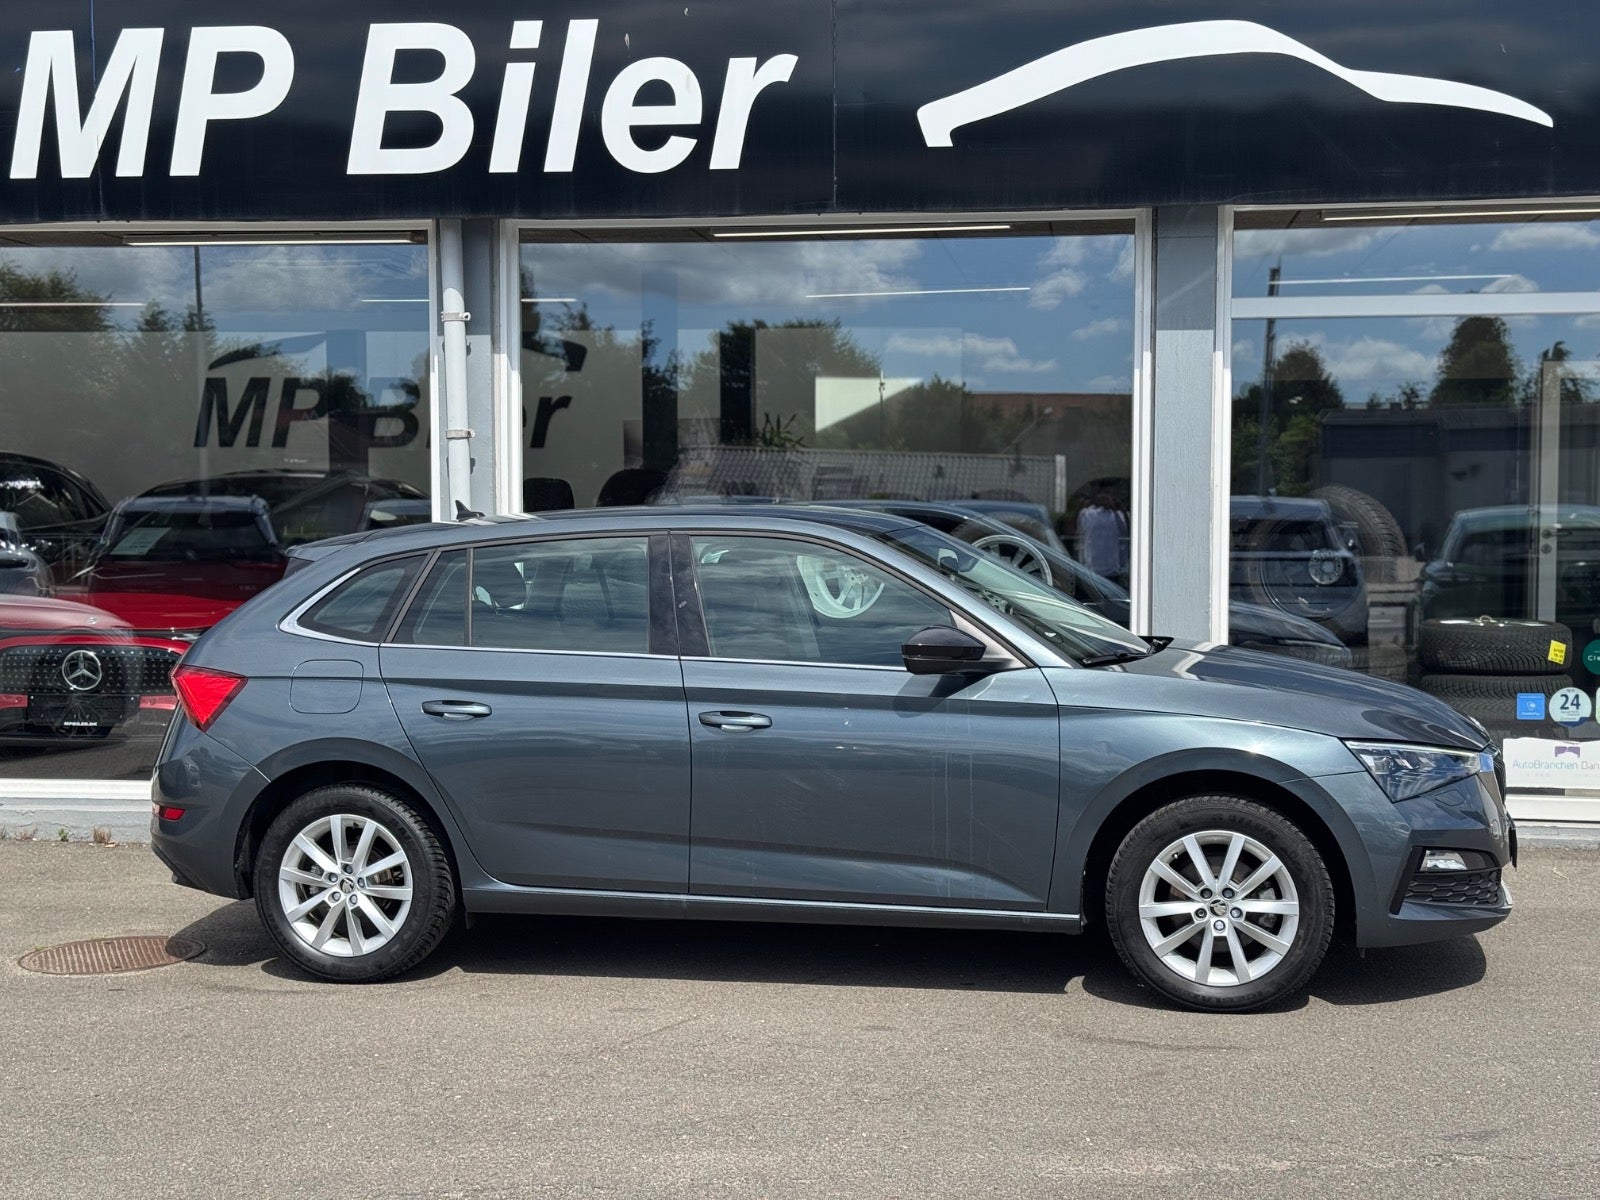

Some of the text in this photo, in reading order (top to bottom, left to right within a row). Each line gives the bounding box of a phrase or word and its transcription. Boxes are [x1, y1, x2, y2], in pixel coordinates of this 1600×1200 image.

[9, 18, 799, 179] MP Biler
[193, 376, 327, 449] MP
[1560, 693, 1581, 710] 24
[1512, 760, 1578, 770] AutoBranchen
